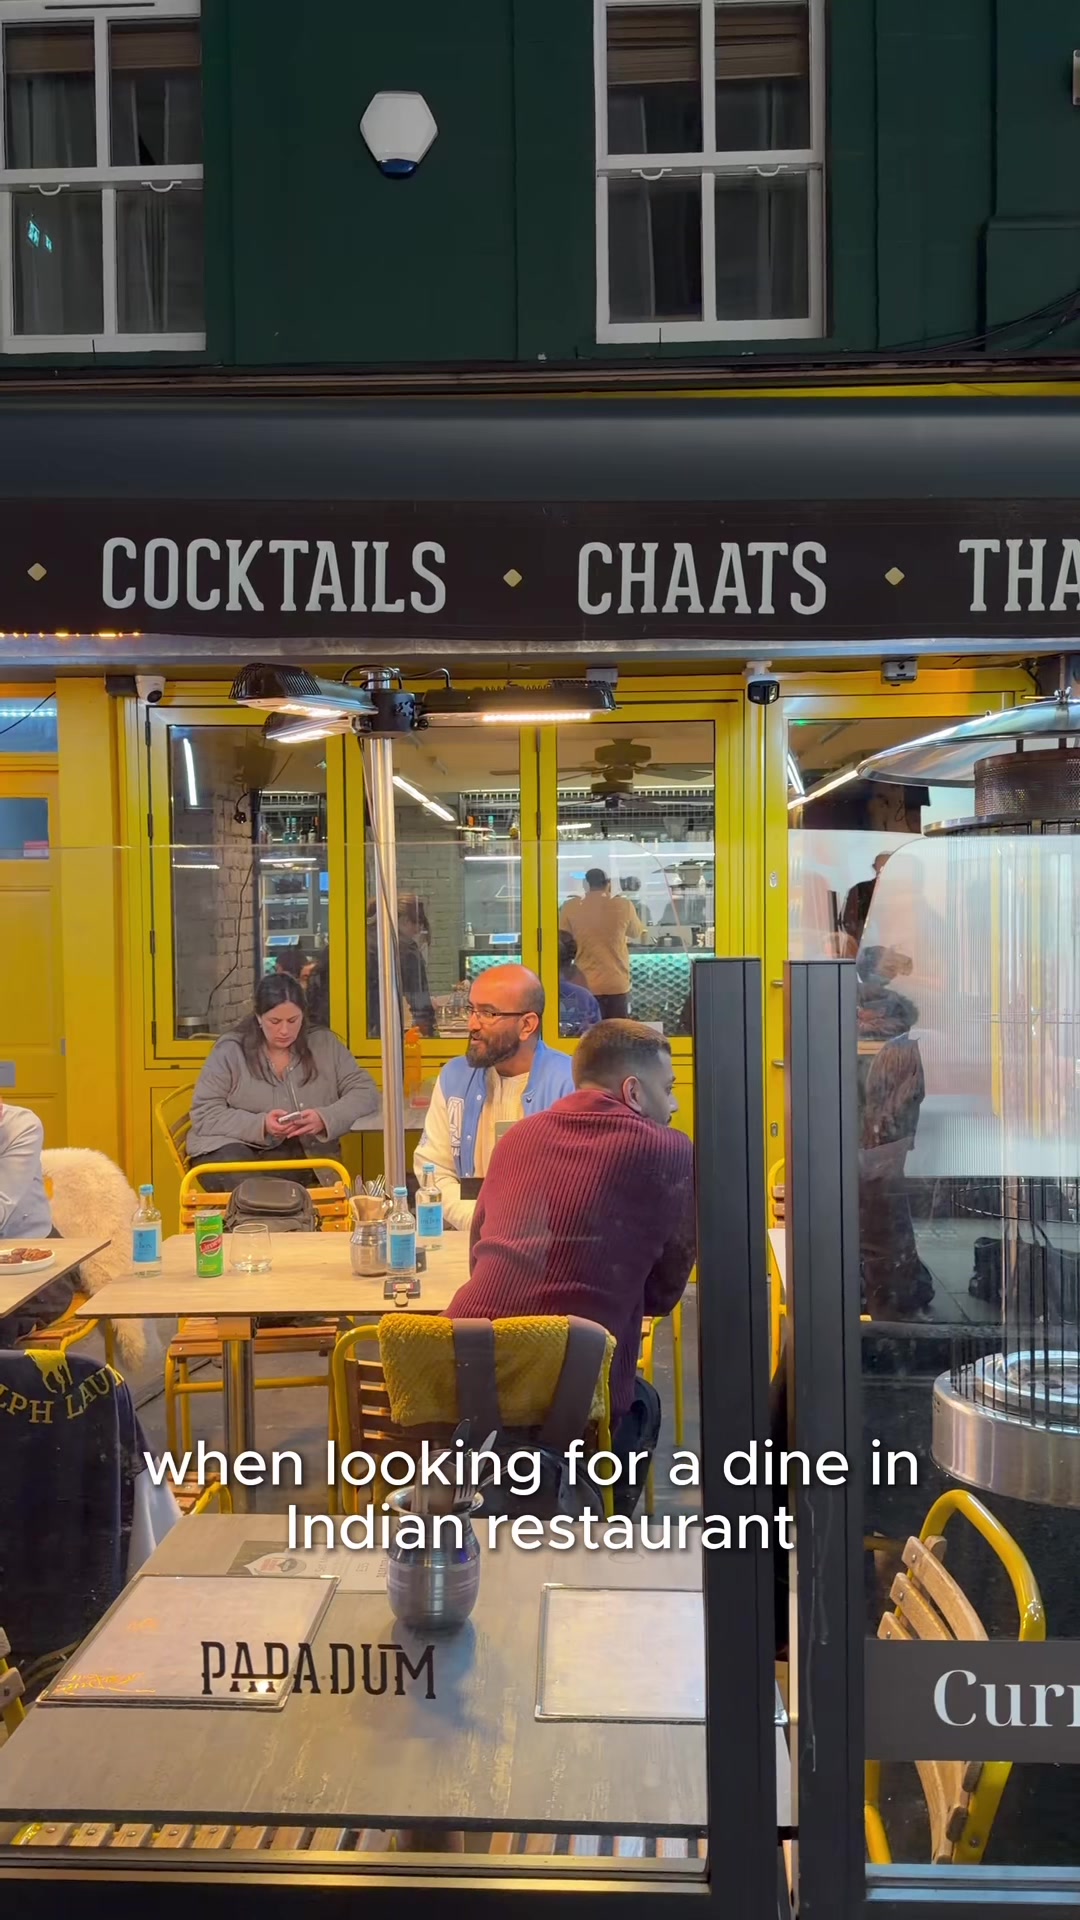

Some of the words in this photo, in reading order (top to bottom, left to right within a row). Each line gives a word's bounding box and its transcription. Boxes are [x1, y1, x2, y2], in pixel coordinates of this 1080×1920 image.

[102, 537, 446, 614] COCKTAILS
[578, 541, 827, 615] CHAATS
[958, 538, 1080, 612] THA
[201, 1641, 437, 1699] PAPADUM
